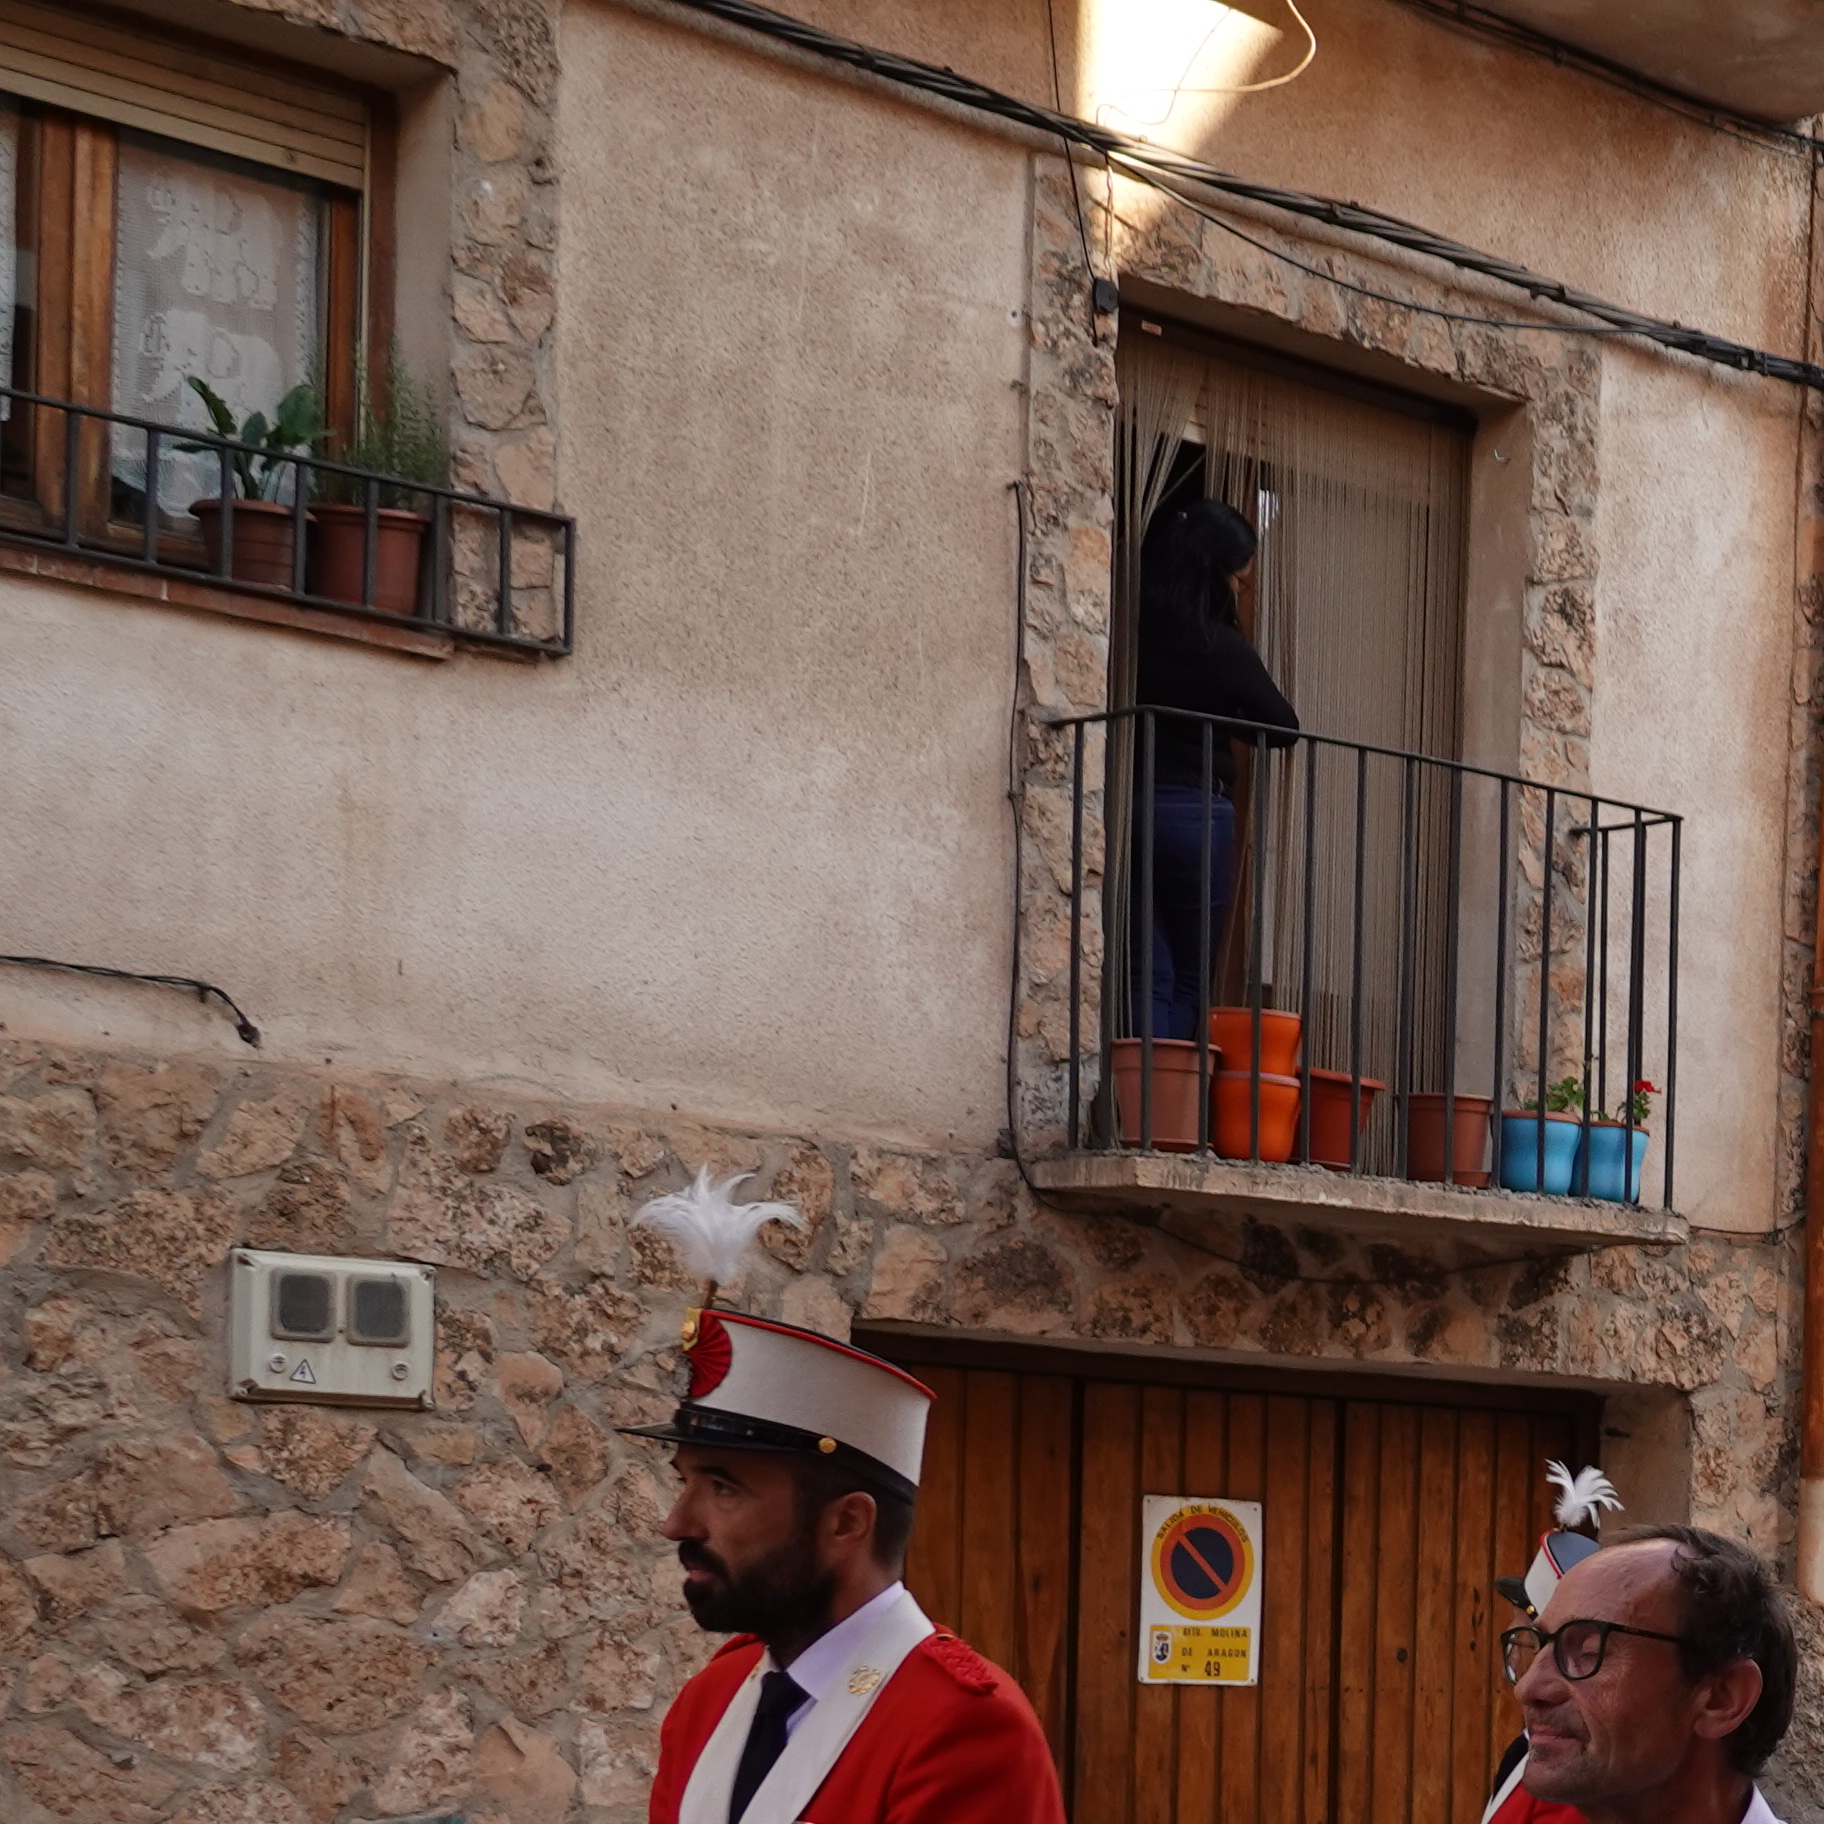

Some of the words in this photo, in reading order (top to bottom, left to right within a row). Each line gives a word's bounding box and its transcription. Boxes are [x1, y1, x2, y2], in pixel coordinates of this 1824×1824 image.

[1211, 1627, 1248, 1638] MOLINA
[1182, 1647, 1193, 1657] DE
[1204, 1660, 1221, 1677] 49
